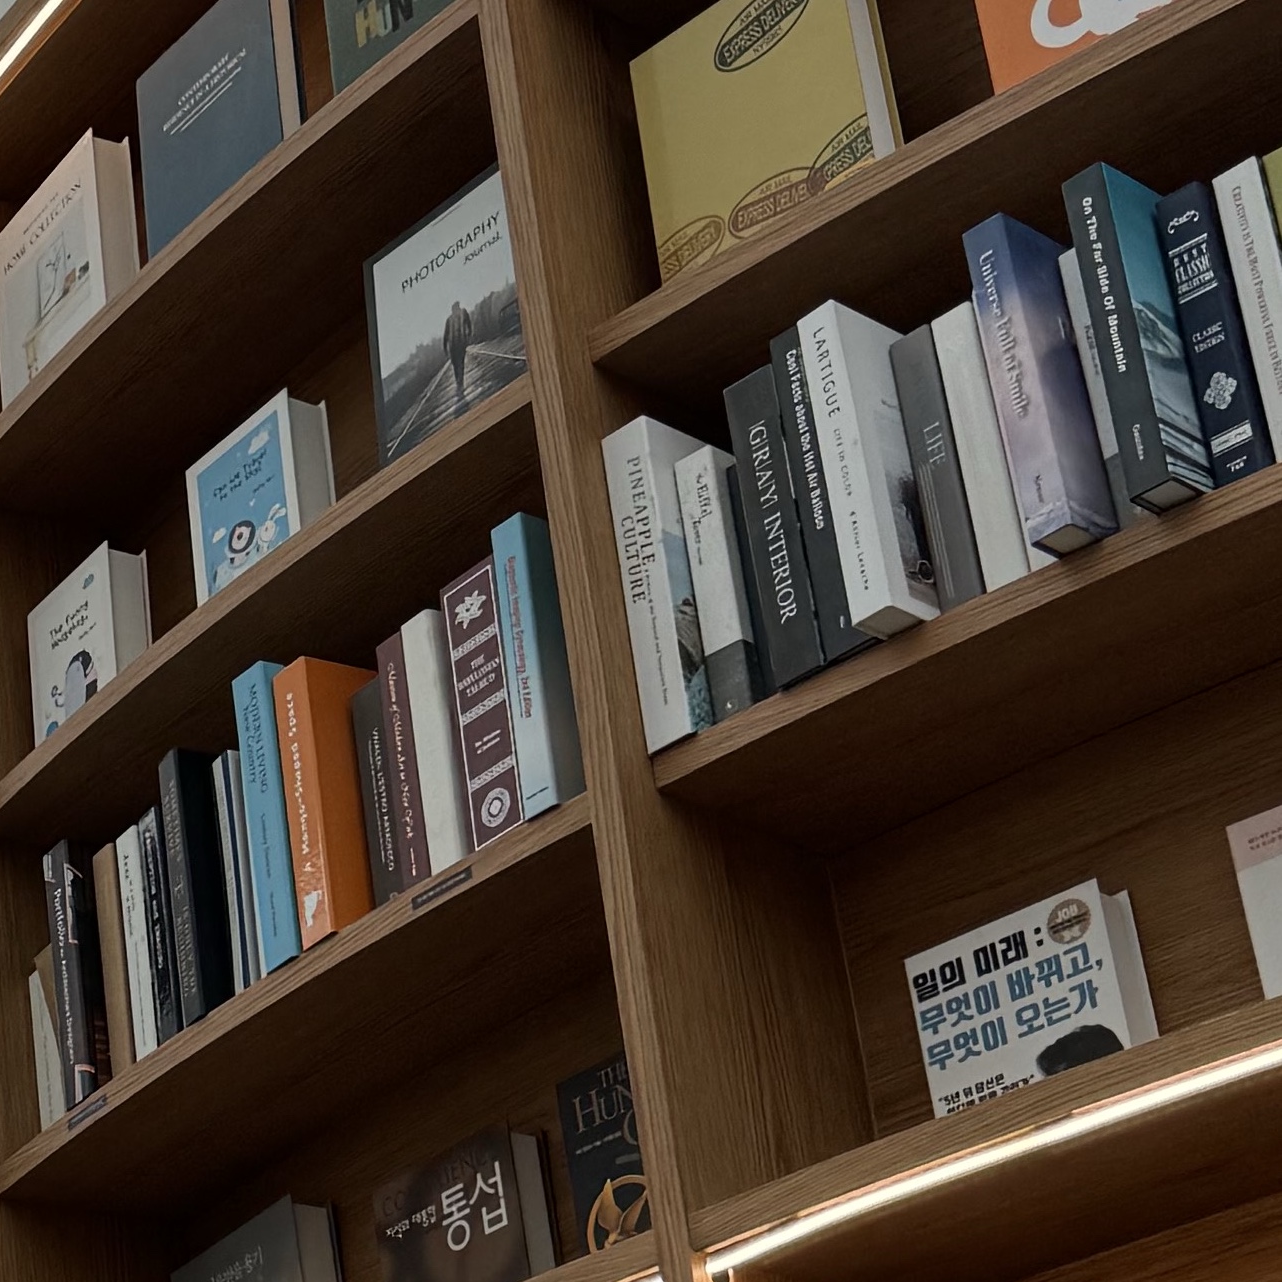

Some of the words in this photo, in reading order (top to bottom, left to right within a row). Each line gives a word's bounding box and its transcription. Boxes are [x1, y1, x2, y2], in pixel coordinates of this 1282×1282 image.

[1080, 194, 1095, 216] On
[1084, 213, 1100, 242] The
[401, 210, 500, 293] PHOTOGRAPHY
[1089, 239, 1106, 266] Far
[1094, 263, 1112, 295] Side
[1175, 258, 1211, 284] CLASSIC
[811, 324, 841, 420] LARTIGUE
[977, 247, 1006, 321] Universe
[1005, 367, 1031, 425] Smile
[1105, 311, 1130, 375] Mountain
[923, 421, 946, 466] LIFE
[620, 512, 646, 605] CULTURE
[761, 510, 799, 626] INTERIOR
[912, 957, 965, 1003] 일의
[971, 931, 1027, 978] 미래
[920, 981, 1000, 1035] 무엇이
[1006, 942, 1103, 997] 바뀌고,
[927, 1016, 1009, 1070] 무엇이
[1015, 979, 1099, 1039] 오는가
[440, 1161, 509, 1252] 통섭
